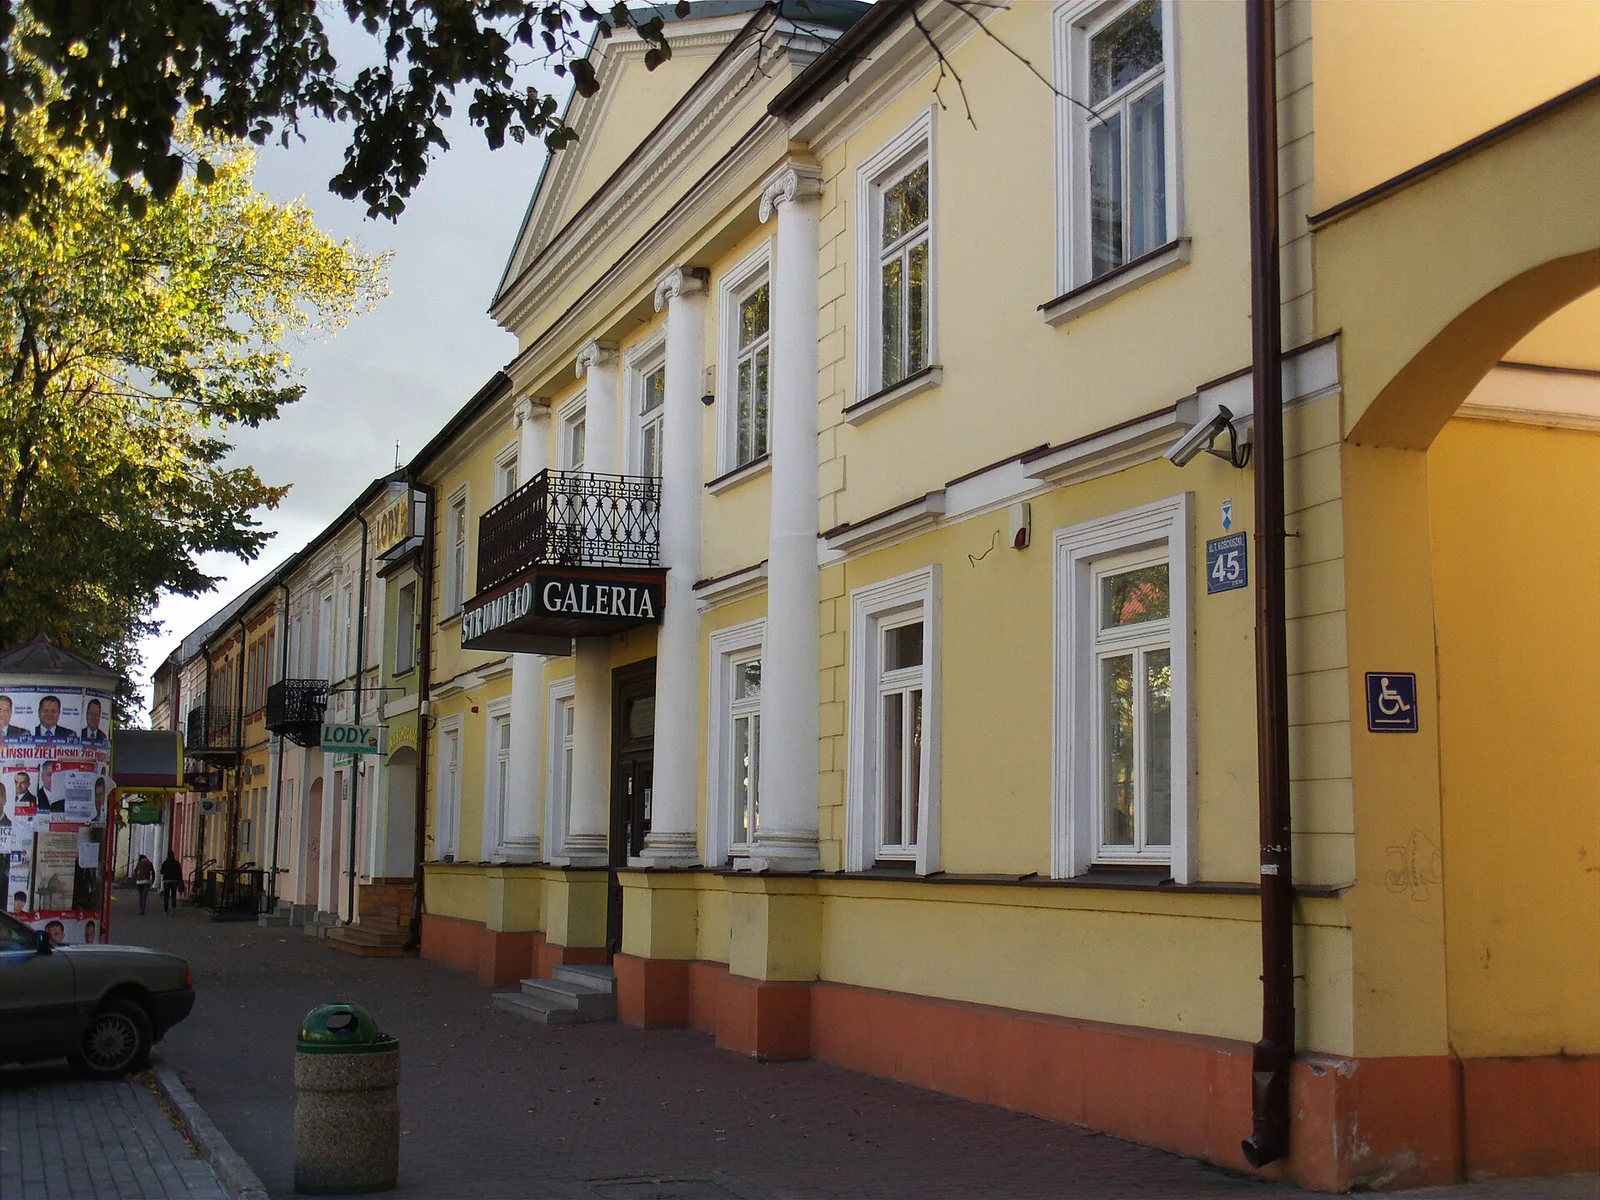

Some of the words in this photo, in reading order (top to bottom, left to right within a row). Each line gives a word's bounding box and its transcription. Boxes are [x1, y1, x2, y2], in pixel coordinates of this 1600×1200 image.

[376, 503, 401, 551] LODY
[1212, 550, 1240, 582] 45
[543, 581, 655, 618] GALERIA
[323, 726, 370, 743] LODY
[34, 745, 78, 759] ZIELIŃSKI
[55, 763, 62, 771] 3
